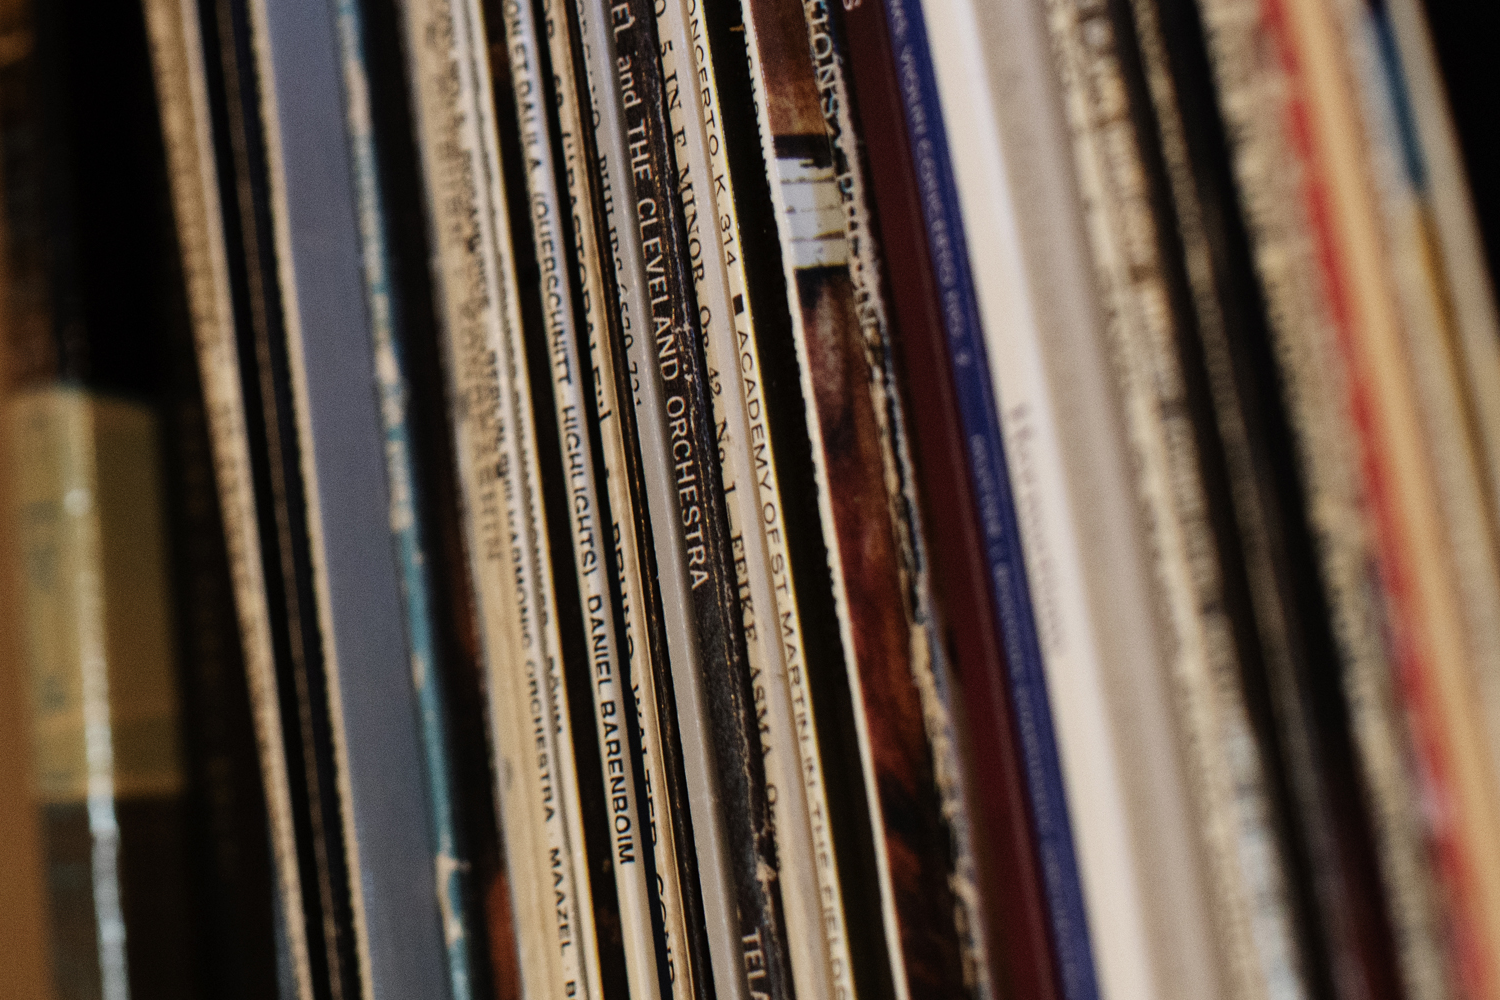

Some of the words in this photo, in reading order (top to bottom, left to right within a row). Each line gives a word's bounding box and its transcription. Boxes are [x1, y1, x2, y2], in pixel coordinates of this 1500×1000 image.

[615, 53, 642, 109] and
[659, 39, 674, 59] 5
[663, 67, 682, 114] IN
[626, 117, 653, 183] THE
[635, 195, 680, 382] CLEVELAND
[718, 211, 737, 266] 314
[735, 328, 772, 493] ACADEMY
[761, 500, 780, 545] OF
[665, 393, 709, 591] ORCHESTRA
[586, 593, 614, 698] DANIEL
[524, 657, 556, 824] ORCHESTRA
[548, 846, 573, 958] MAAZEL
[599, 698, 635, 865] BARENBOIM
